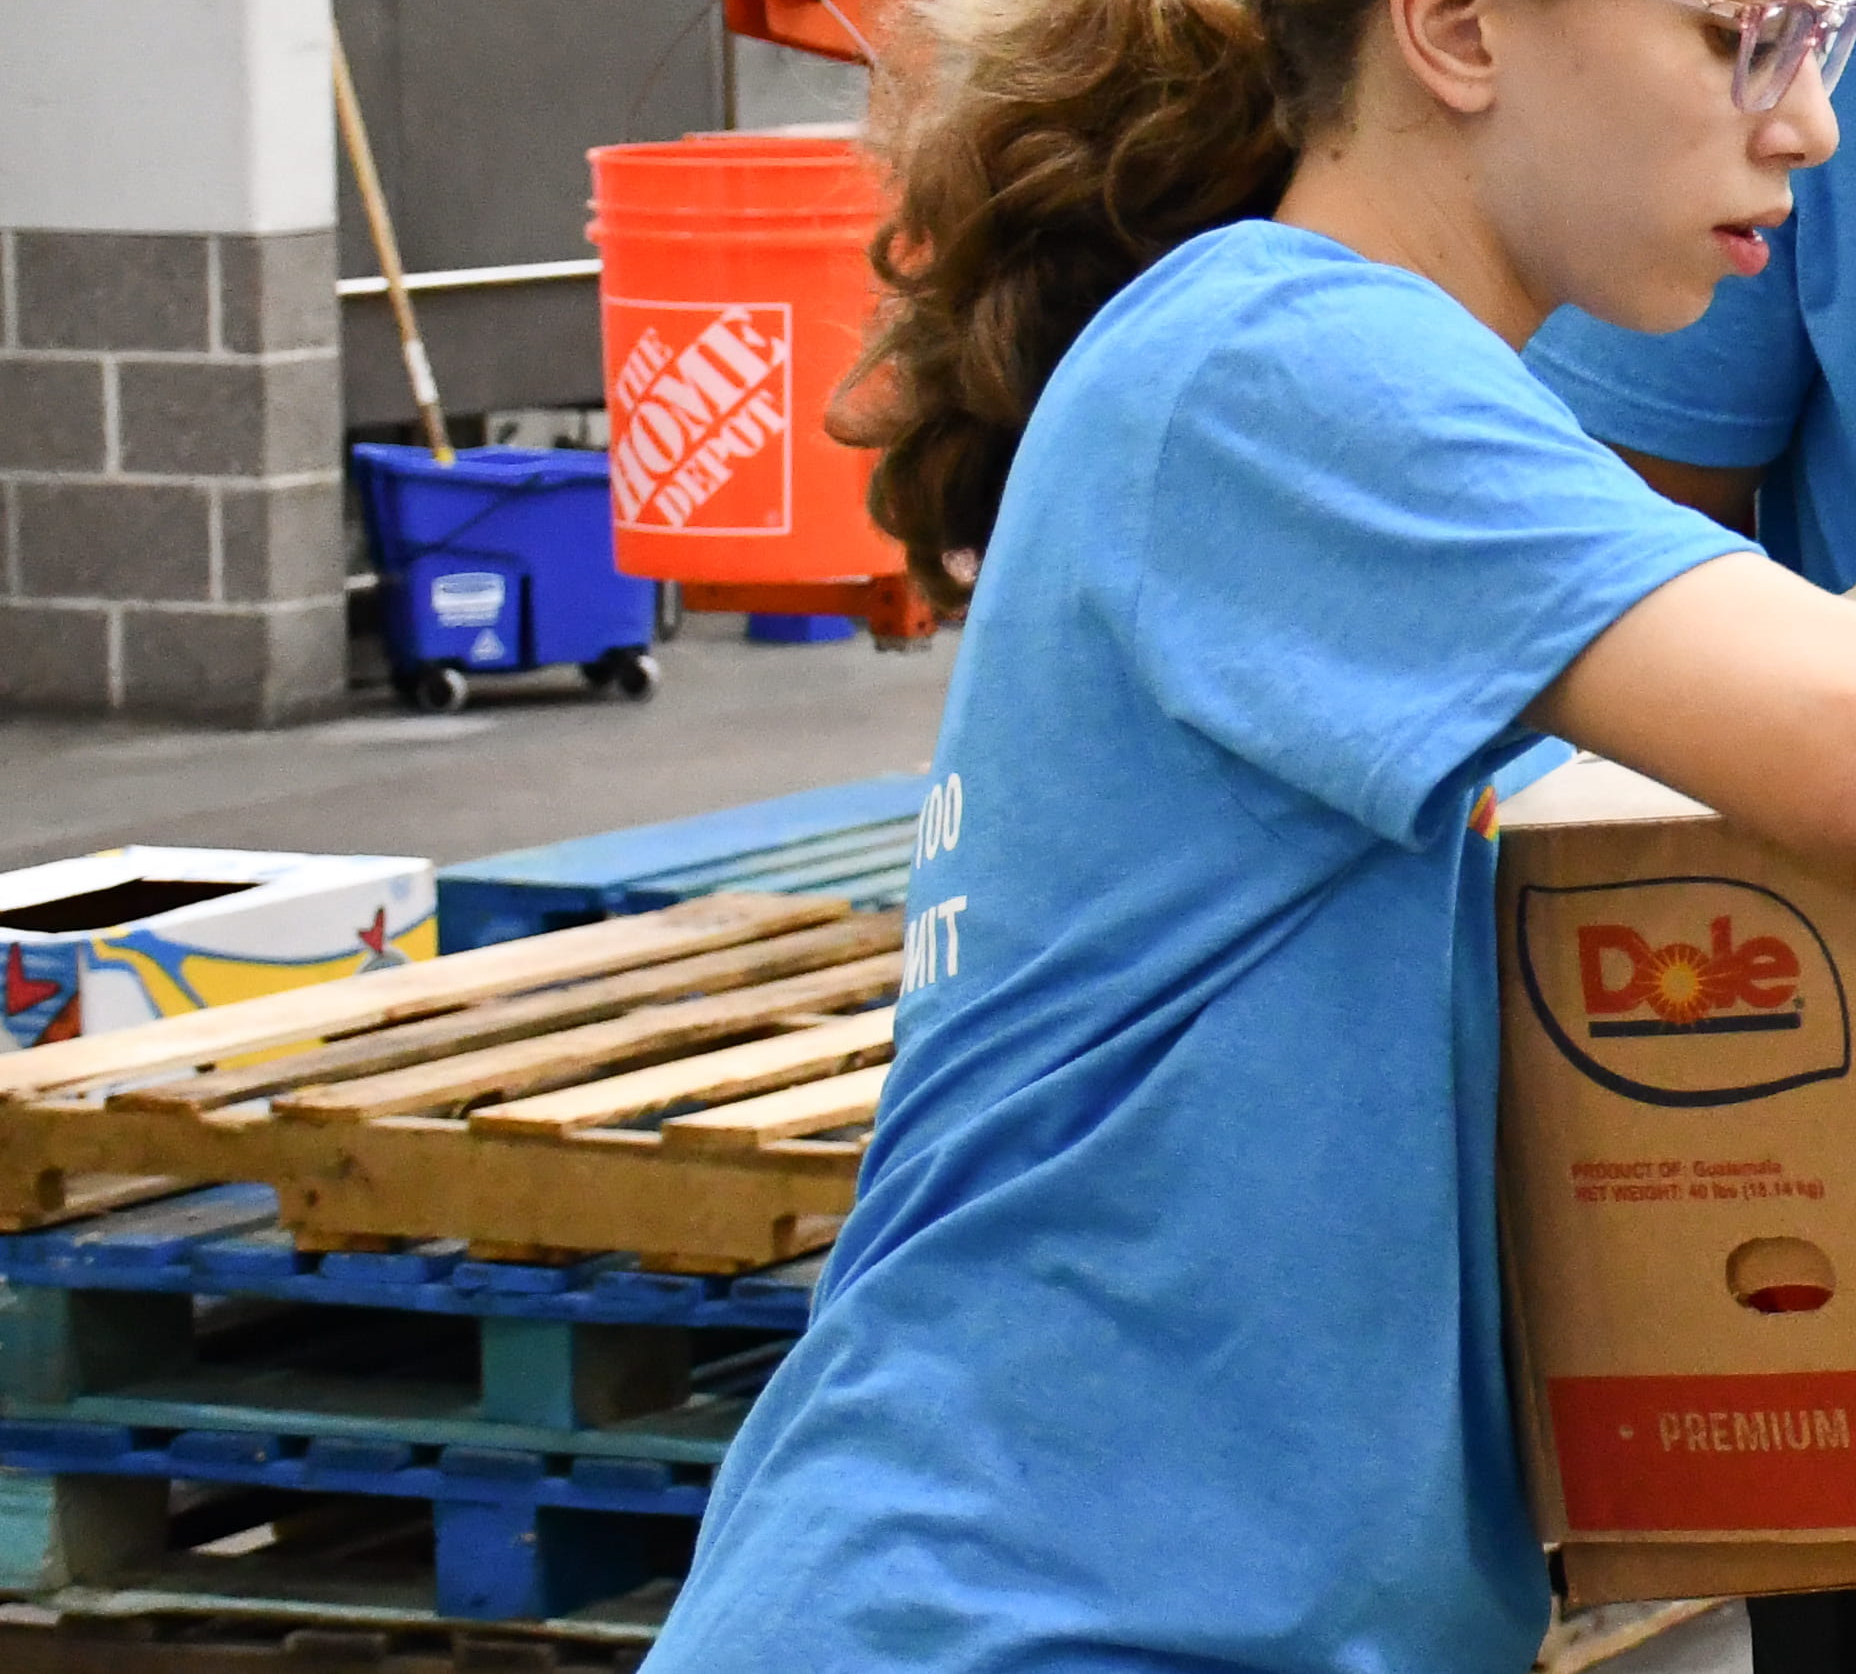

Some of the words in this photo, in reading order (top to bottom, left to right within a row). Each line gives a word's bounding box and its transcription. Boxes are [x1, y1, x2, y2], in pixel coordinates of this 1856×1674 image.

[611, 307, 787, 524] HOME
[616, 327, 674, 411] THE
[654, 389, 787, 528] DEPOT
[1577, 914, 1800, 1025] Dole
[1658, 1406, 1851, 1454] PREMIUM
